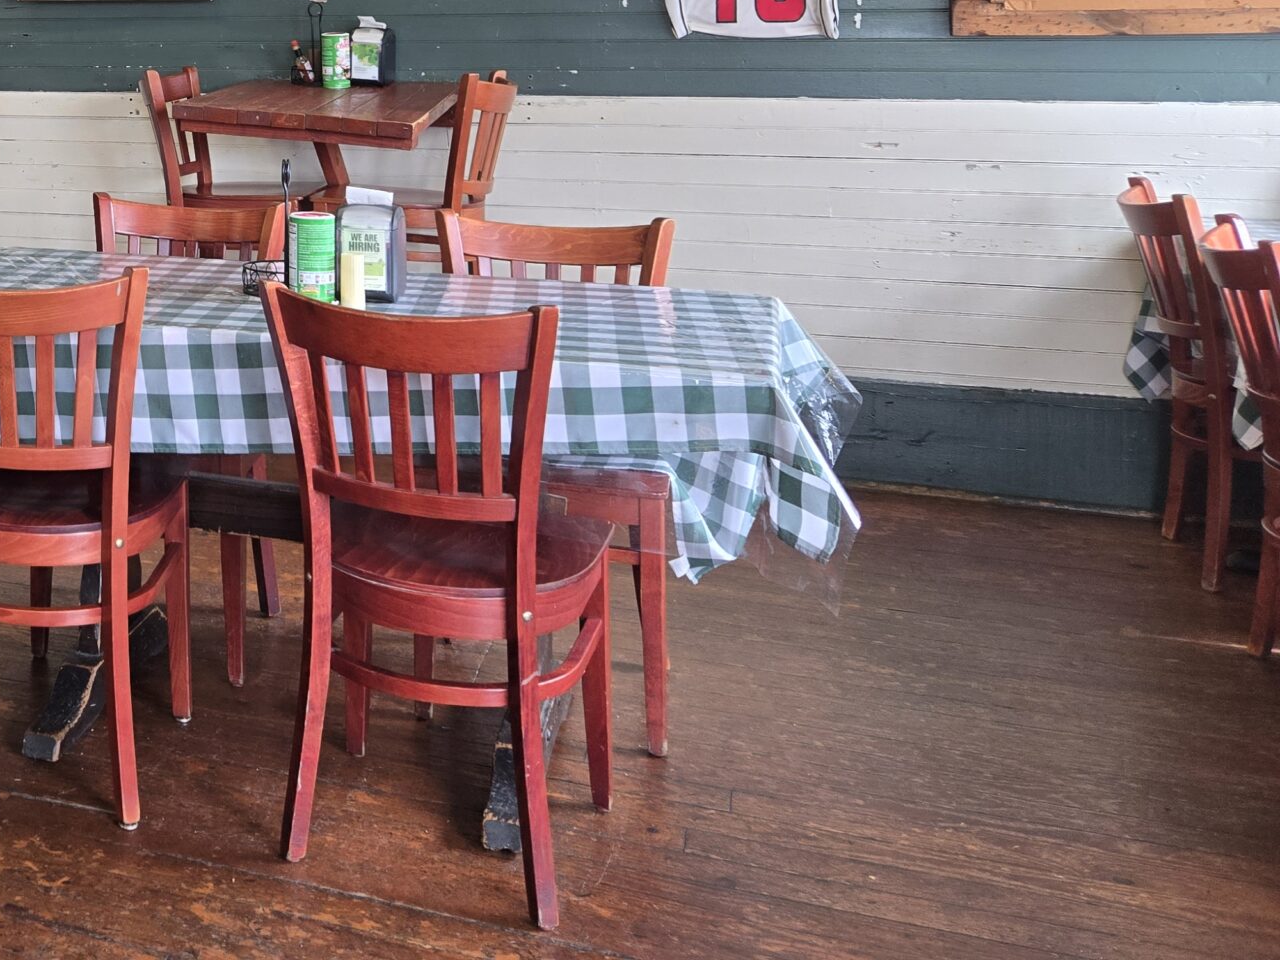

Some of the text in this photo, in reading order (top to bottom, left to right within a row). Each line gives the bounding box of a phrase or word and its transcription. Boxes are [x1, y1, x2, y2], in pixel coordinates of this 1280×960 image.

[351, 233, 378, 241] WE ARE
[348, 241, 380, 253] HIRING
